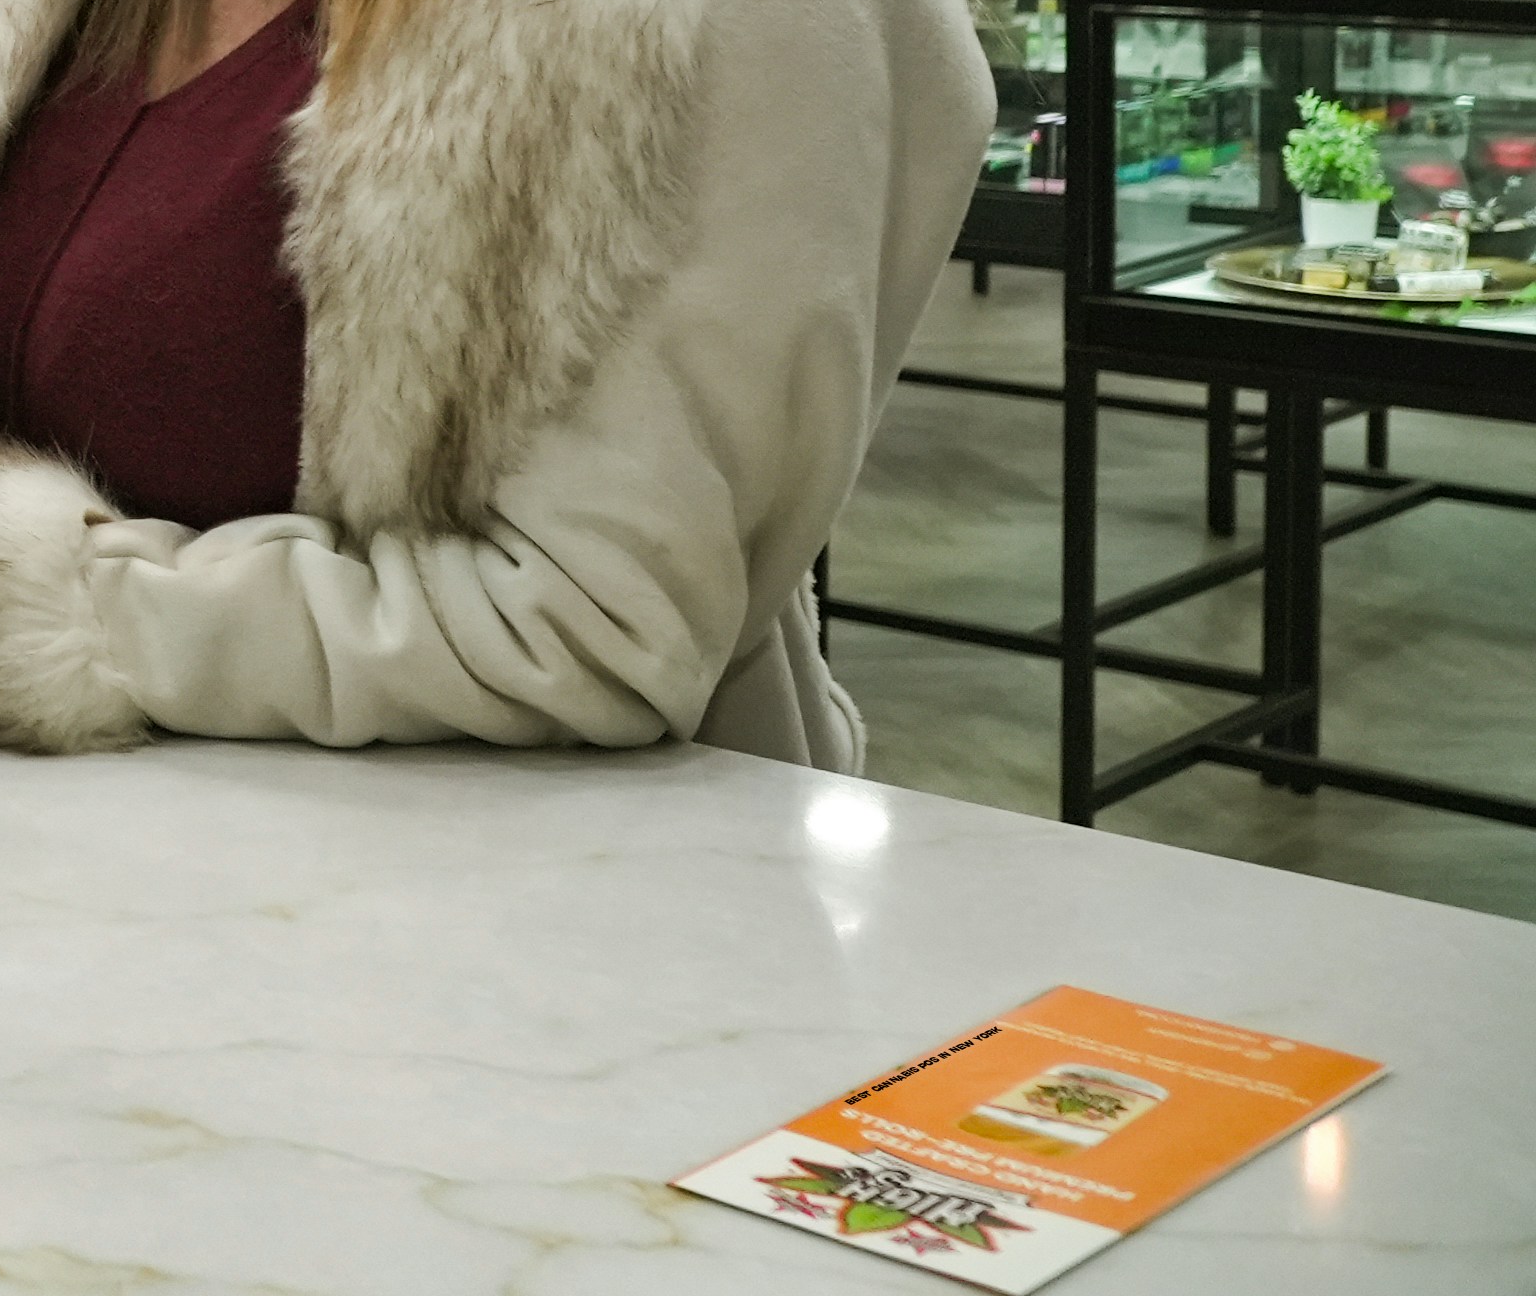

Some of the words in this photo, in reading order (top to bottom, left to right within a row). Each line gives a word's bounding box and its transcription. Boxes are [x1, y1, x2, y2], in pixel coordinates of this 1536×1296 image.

[860, 1128, 991, 1176] CRAFTED
[994, 1170, 1086, 1202] HAND
[995, 1156, 1135, 1201] PREMIUM
[836, 1178, 988, 1228] HIGH
